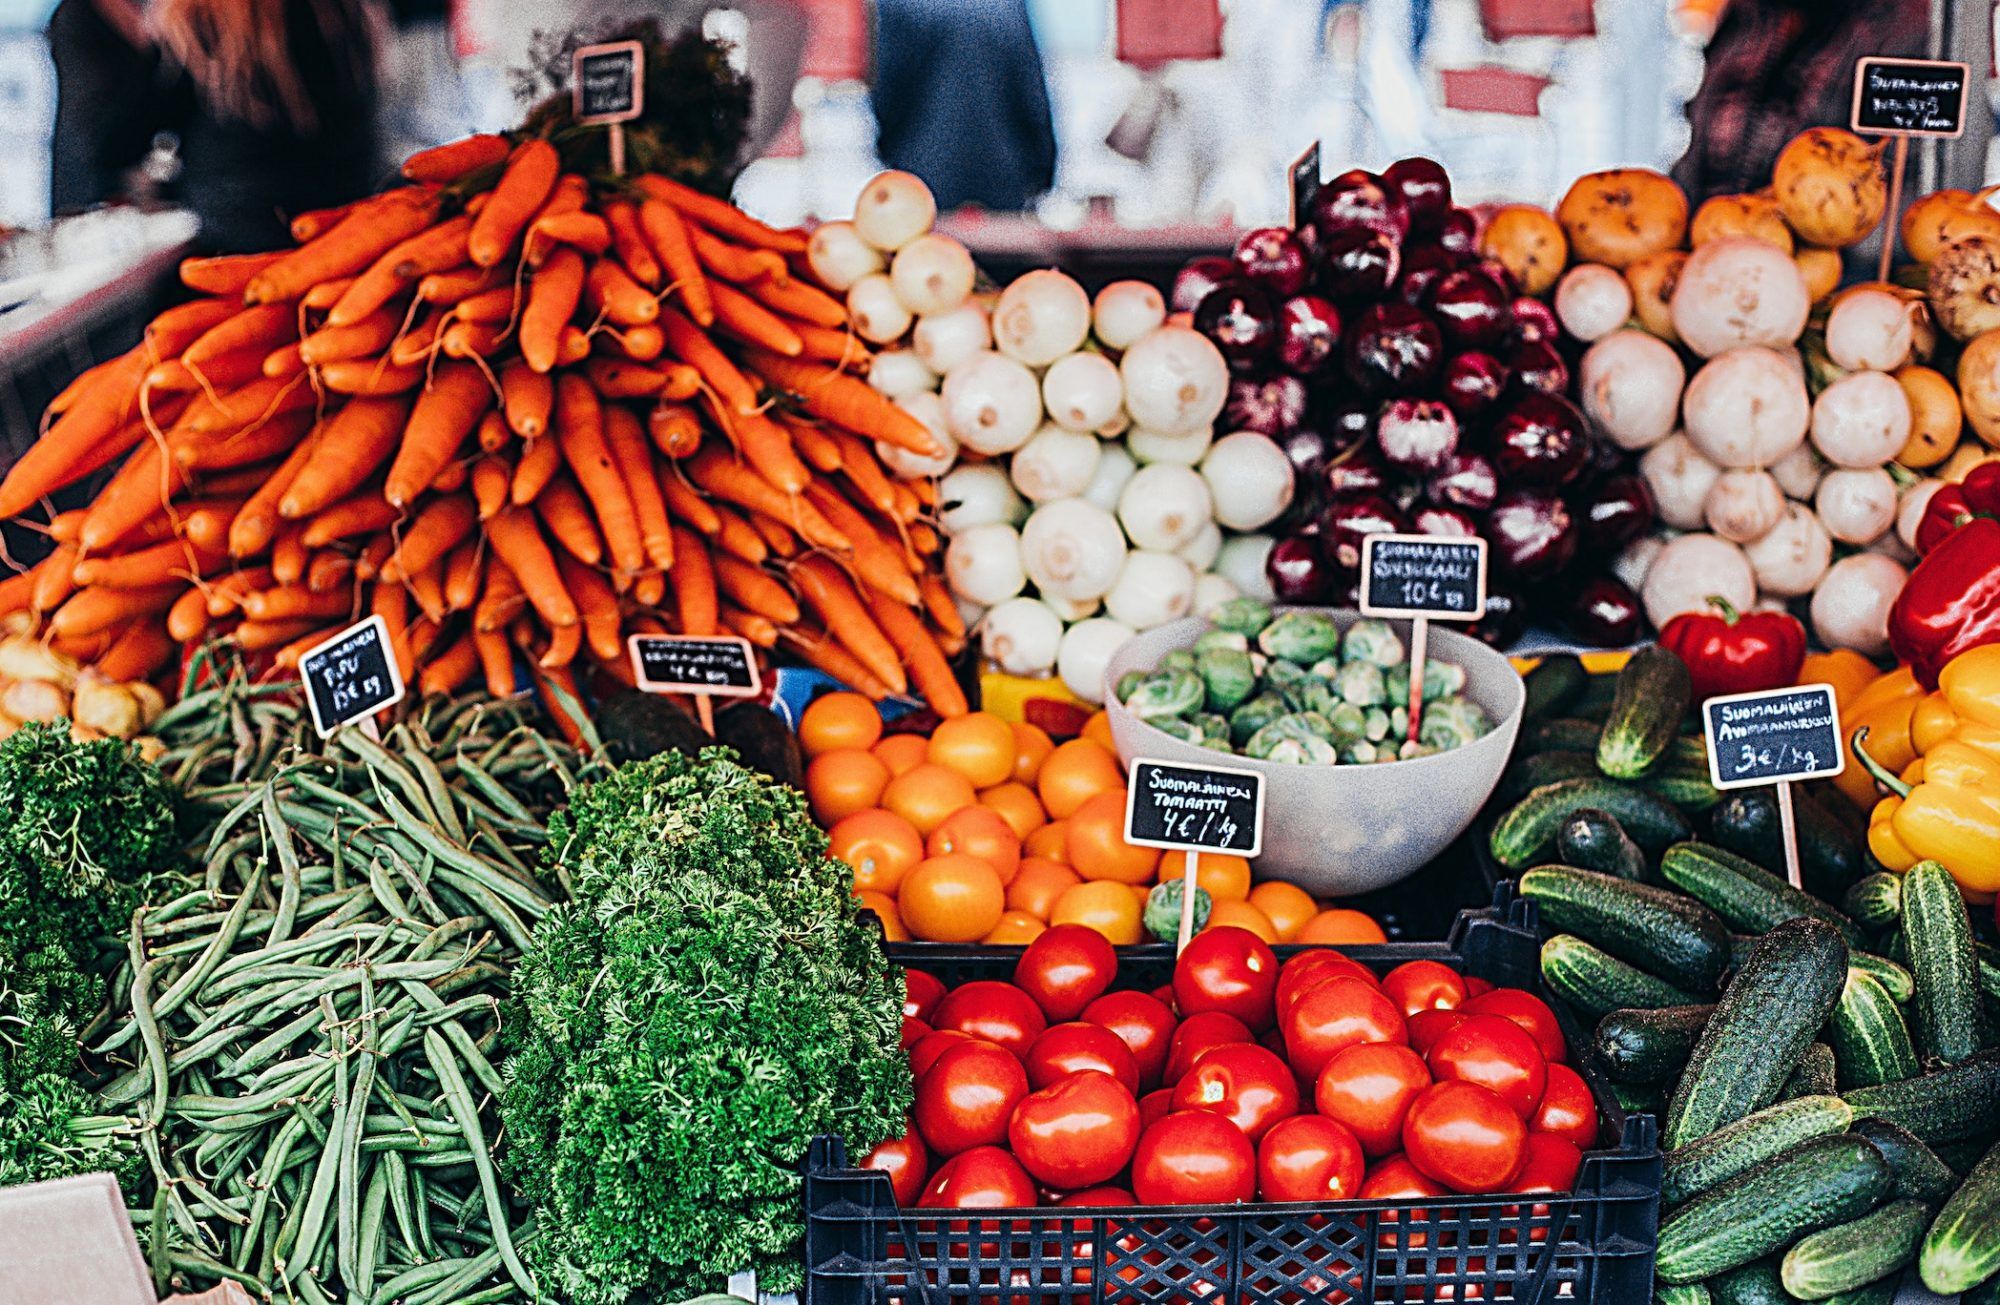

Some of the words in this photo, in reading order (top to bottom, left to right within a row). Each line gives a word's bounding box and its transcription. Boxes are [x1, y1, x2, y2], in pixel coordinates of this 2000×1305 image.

[1721, 696, 1823, 722] SUOMALAINEN
[1149, 768, 1251, 799] SUOMALAINEN
[1153, 793, 1227, 813] TOMAATTI
